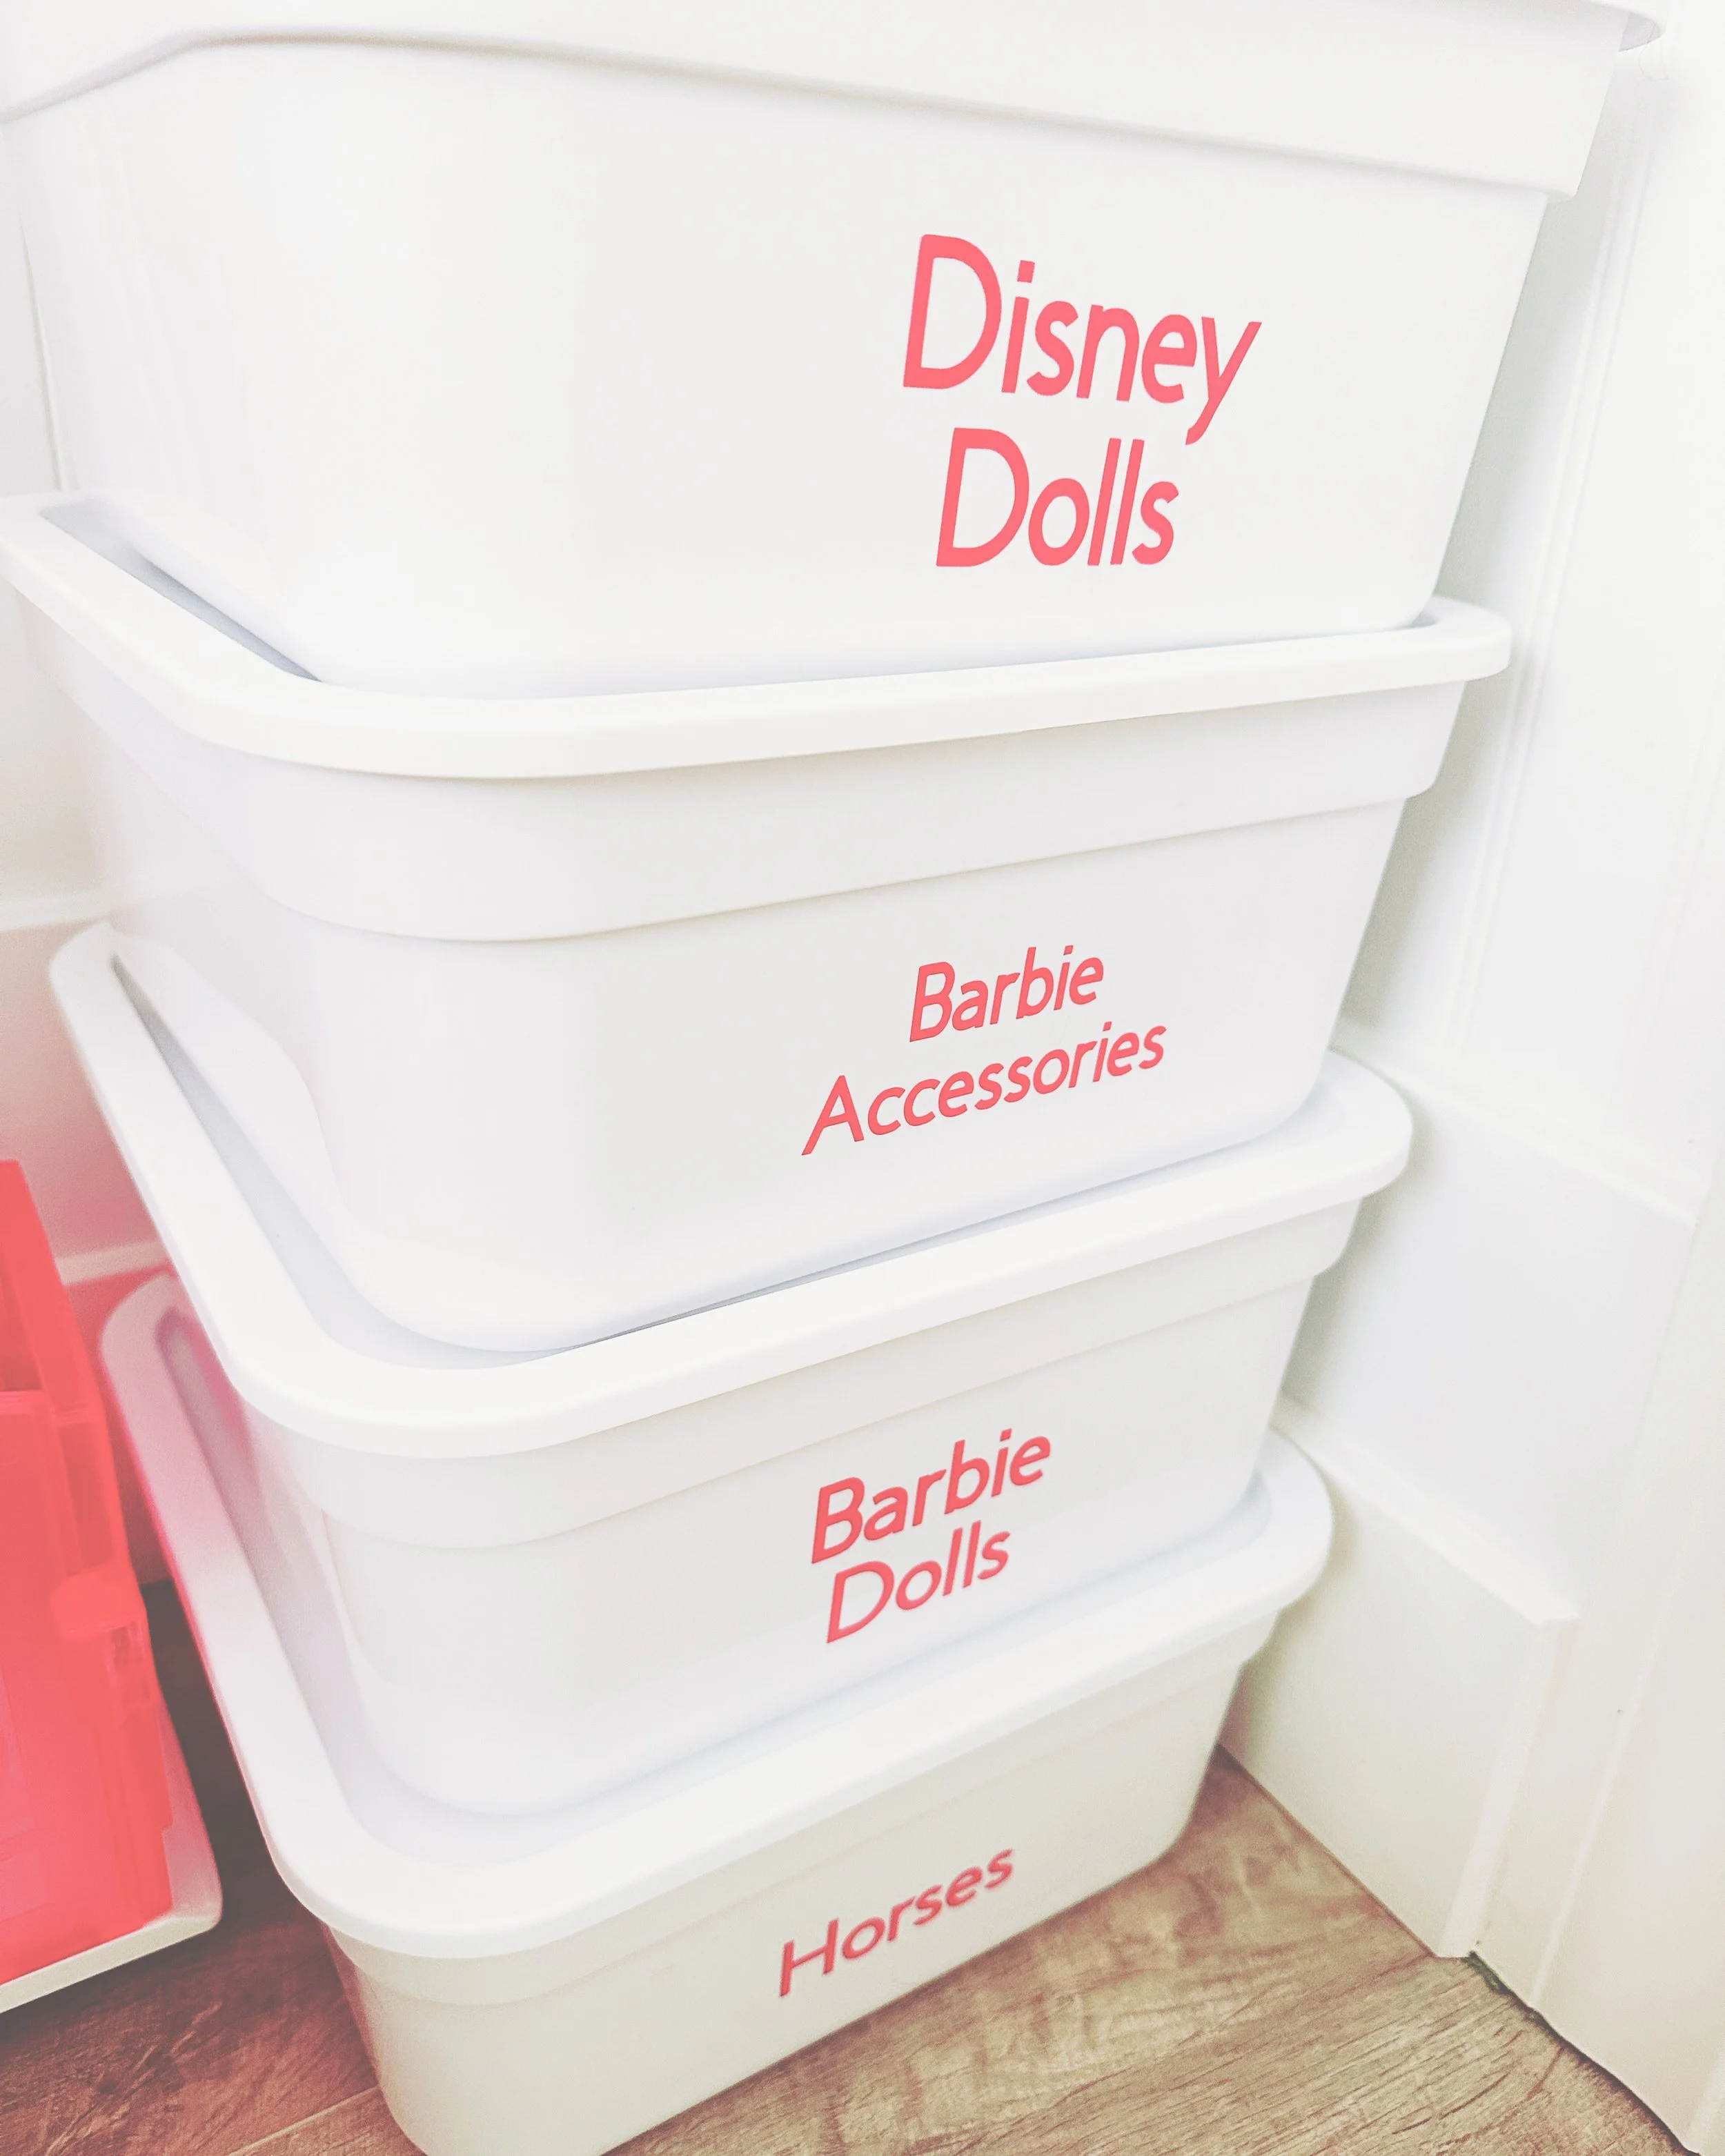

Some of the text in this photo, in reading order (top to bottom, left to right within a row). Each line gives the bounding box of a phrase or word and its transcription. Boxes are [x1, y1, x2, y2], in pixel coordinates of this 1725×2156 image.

[903, 233, 1262, 446] Disney
[935, 426, 1180, 568] Dolls
[909, 944, 1105, 1042] Barbie
[801, 1022, 1167, 1156] Accessories
[811, 1427, 1052, 1565] Barbie
[826, 1520, 1011, 1644] Dolls
[779, 1849, 1014, 1998] Horses
